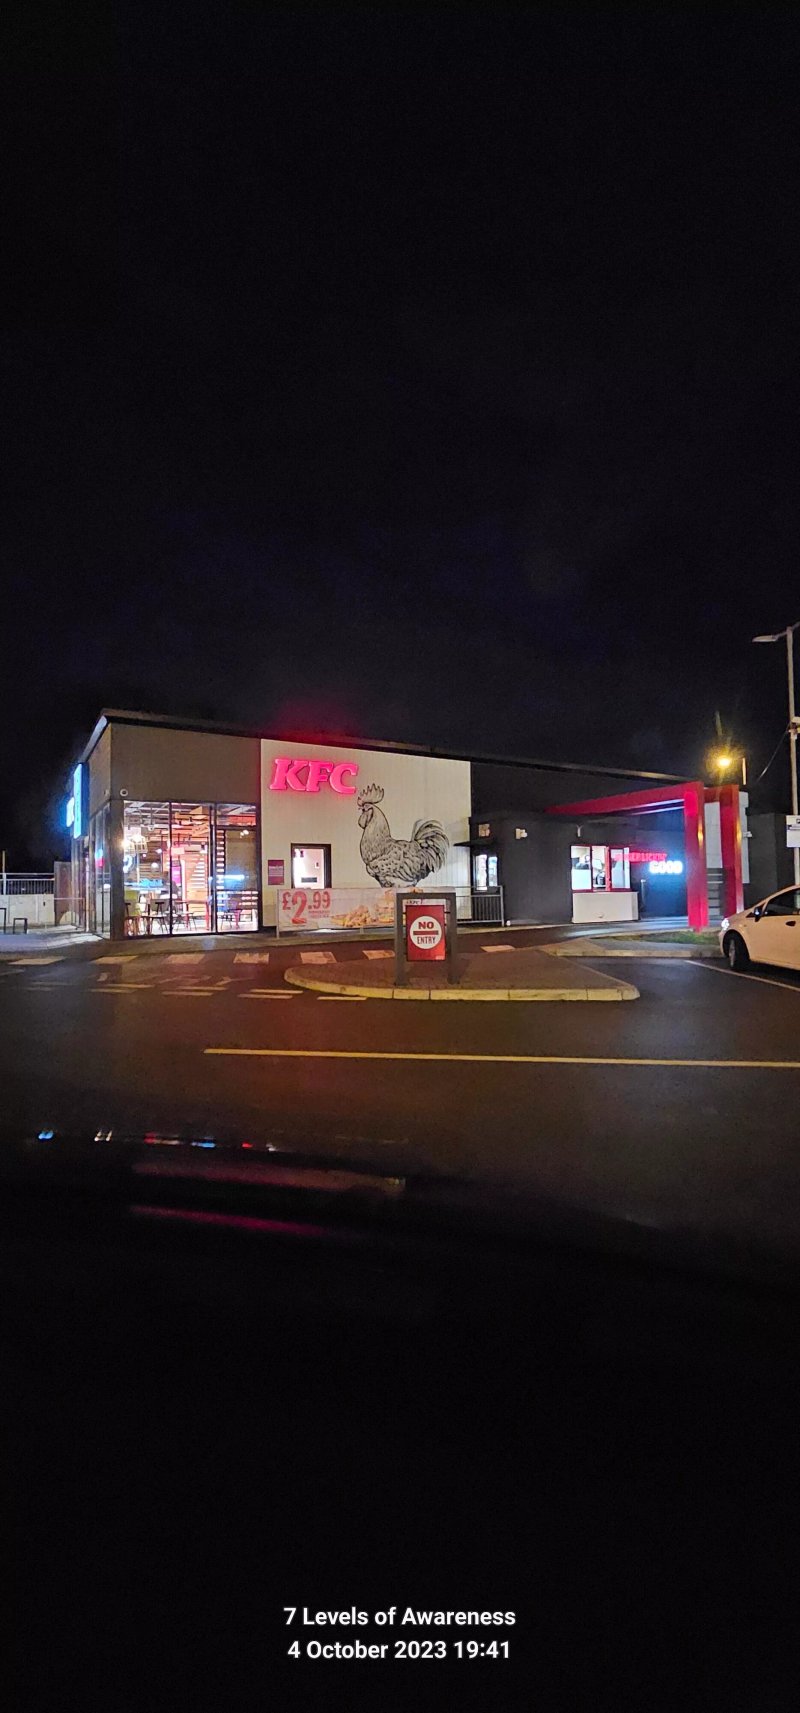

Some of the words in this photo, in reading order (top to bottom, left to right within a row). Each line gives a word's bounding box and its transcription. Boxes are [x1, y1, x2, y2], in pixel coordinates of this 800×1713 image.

[269, 758, 358, 794] KFC
[649, 860, 683, 874] GOOD
[282, 890, 331, 925] £2.99
[418, 921, 435, 930] NO
[416, 936, 437, 945] ENTRY
